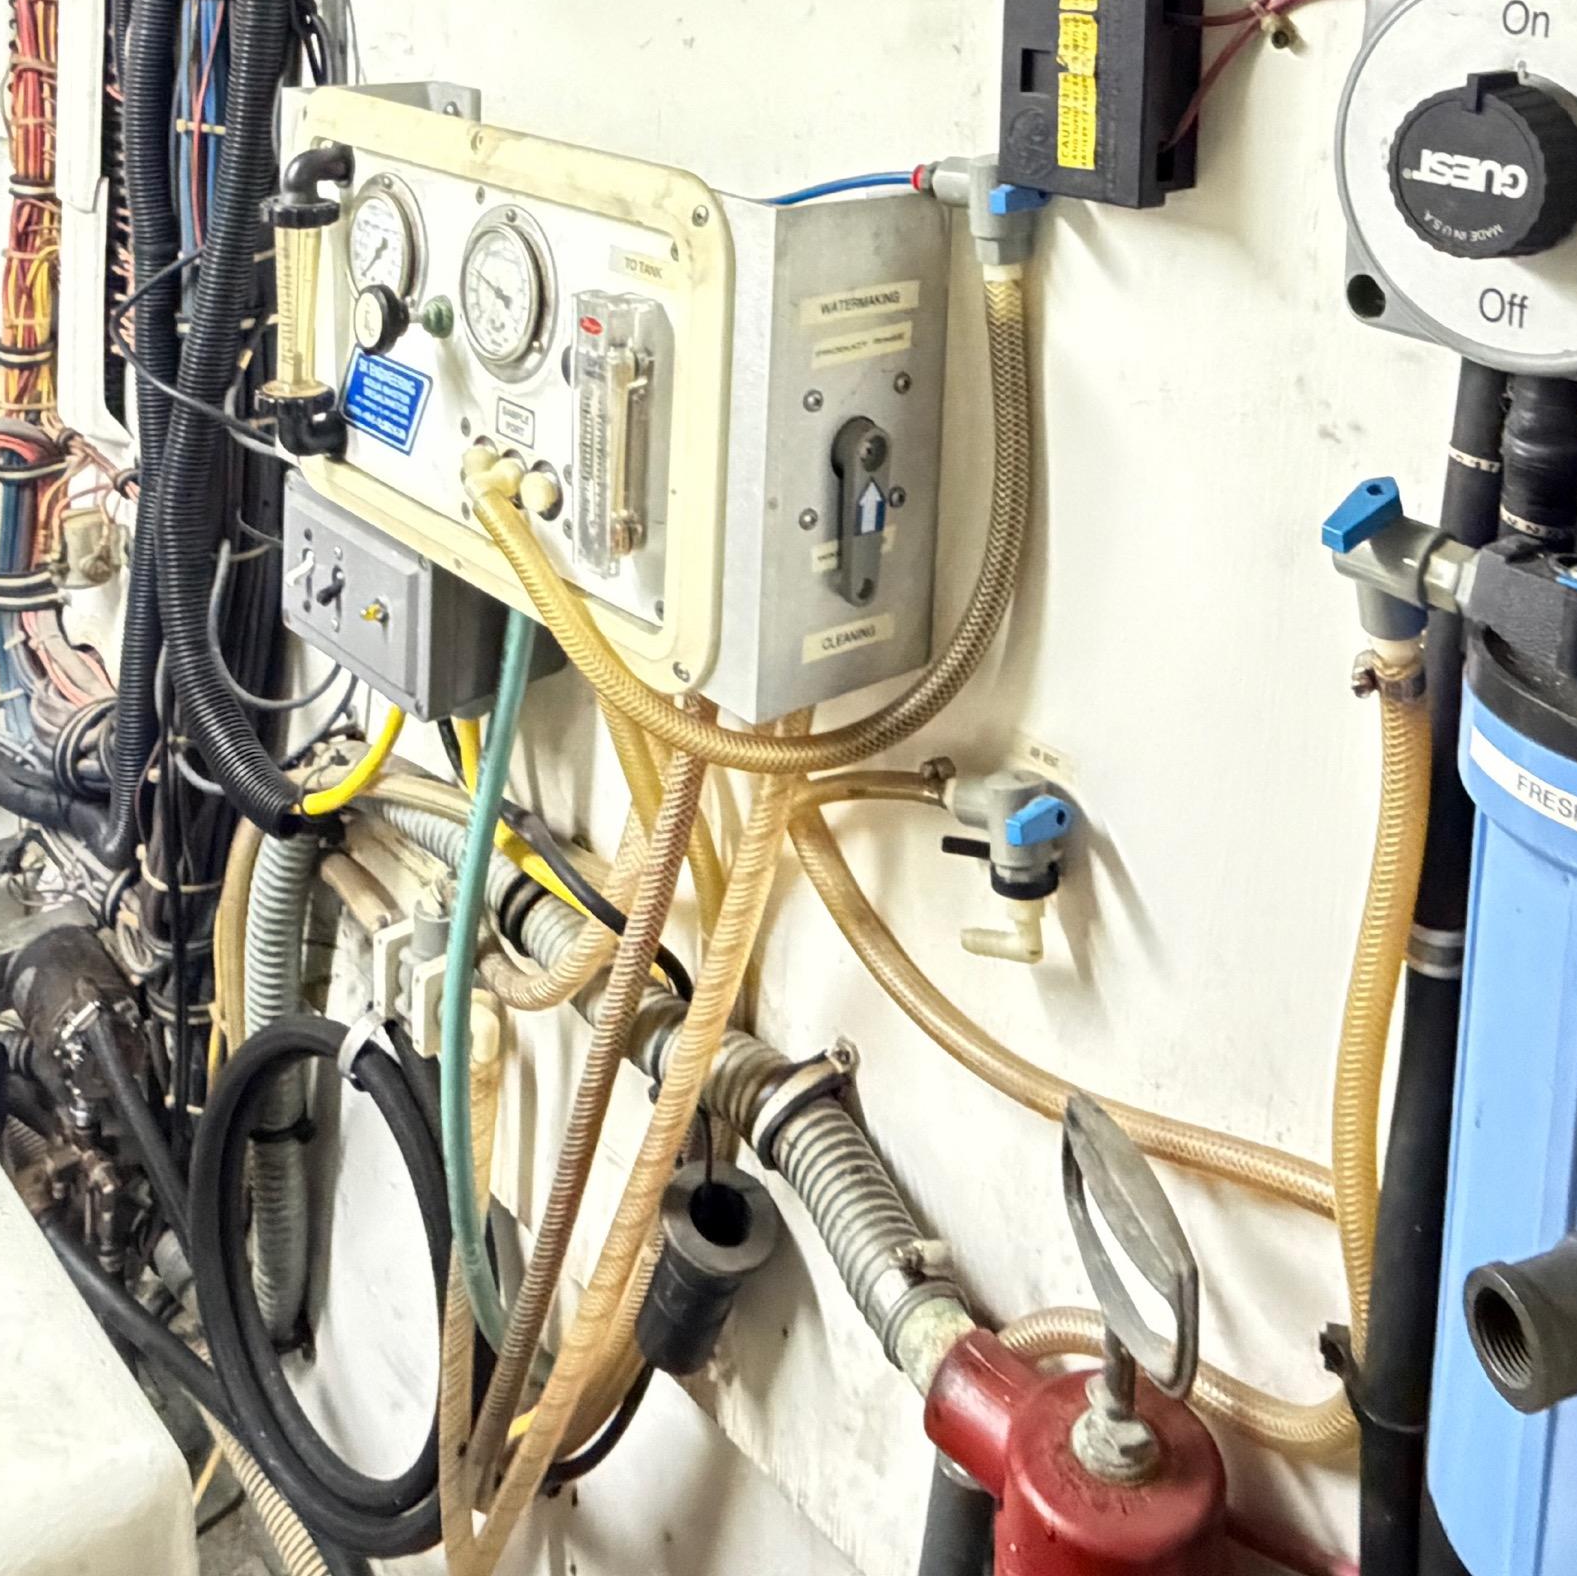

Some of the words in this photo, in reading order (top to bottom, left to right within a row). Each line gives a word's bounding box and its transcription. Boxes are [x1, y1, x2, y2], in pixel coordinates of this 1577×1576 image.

[1502, 0, 1550, 38] On
[1410, 148, 1528, 199] GUEST
[1452, 227, 1468, 240] IN
[1471, 223, 1505, 242] MADE
[624, 256, 638, 271] TO
[639, 260, 664, 280] TANK
[820, 290, 901, 315] WATERMAKING
[1479, 287, 1529, 329] Off
[821, 624, 877, 651] CLEANING
